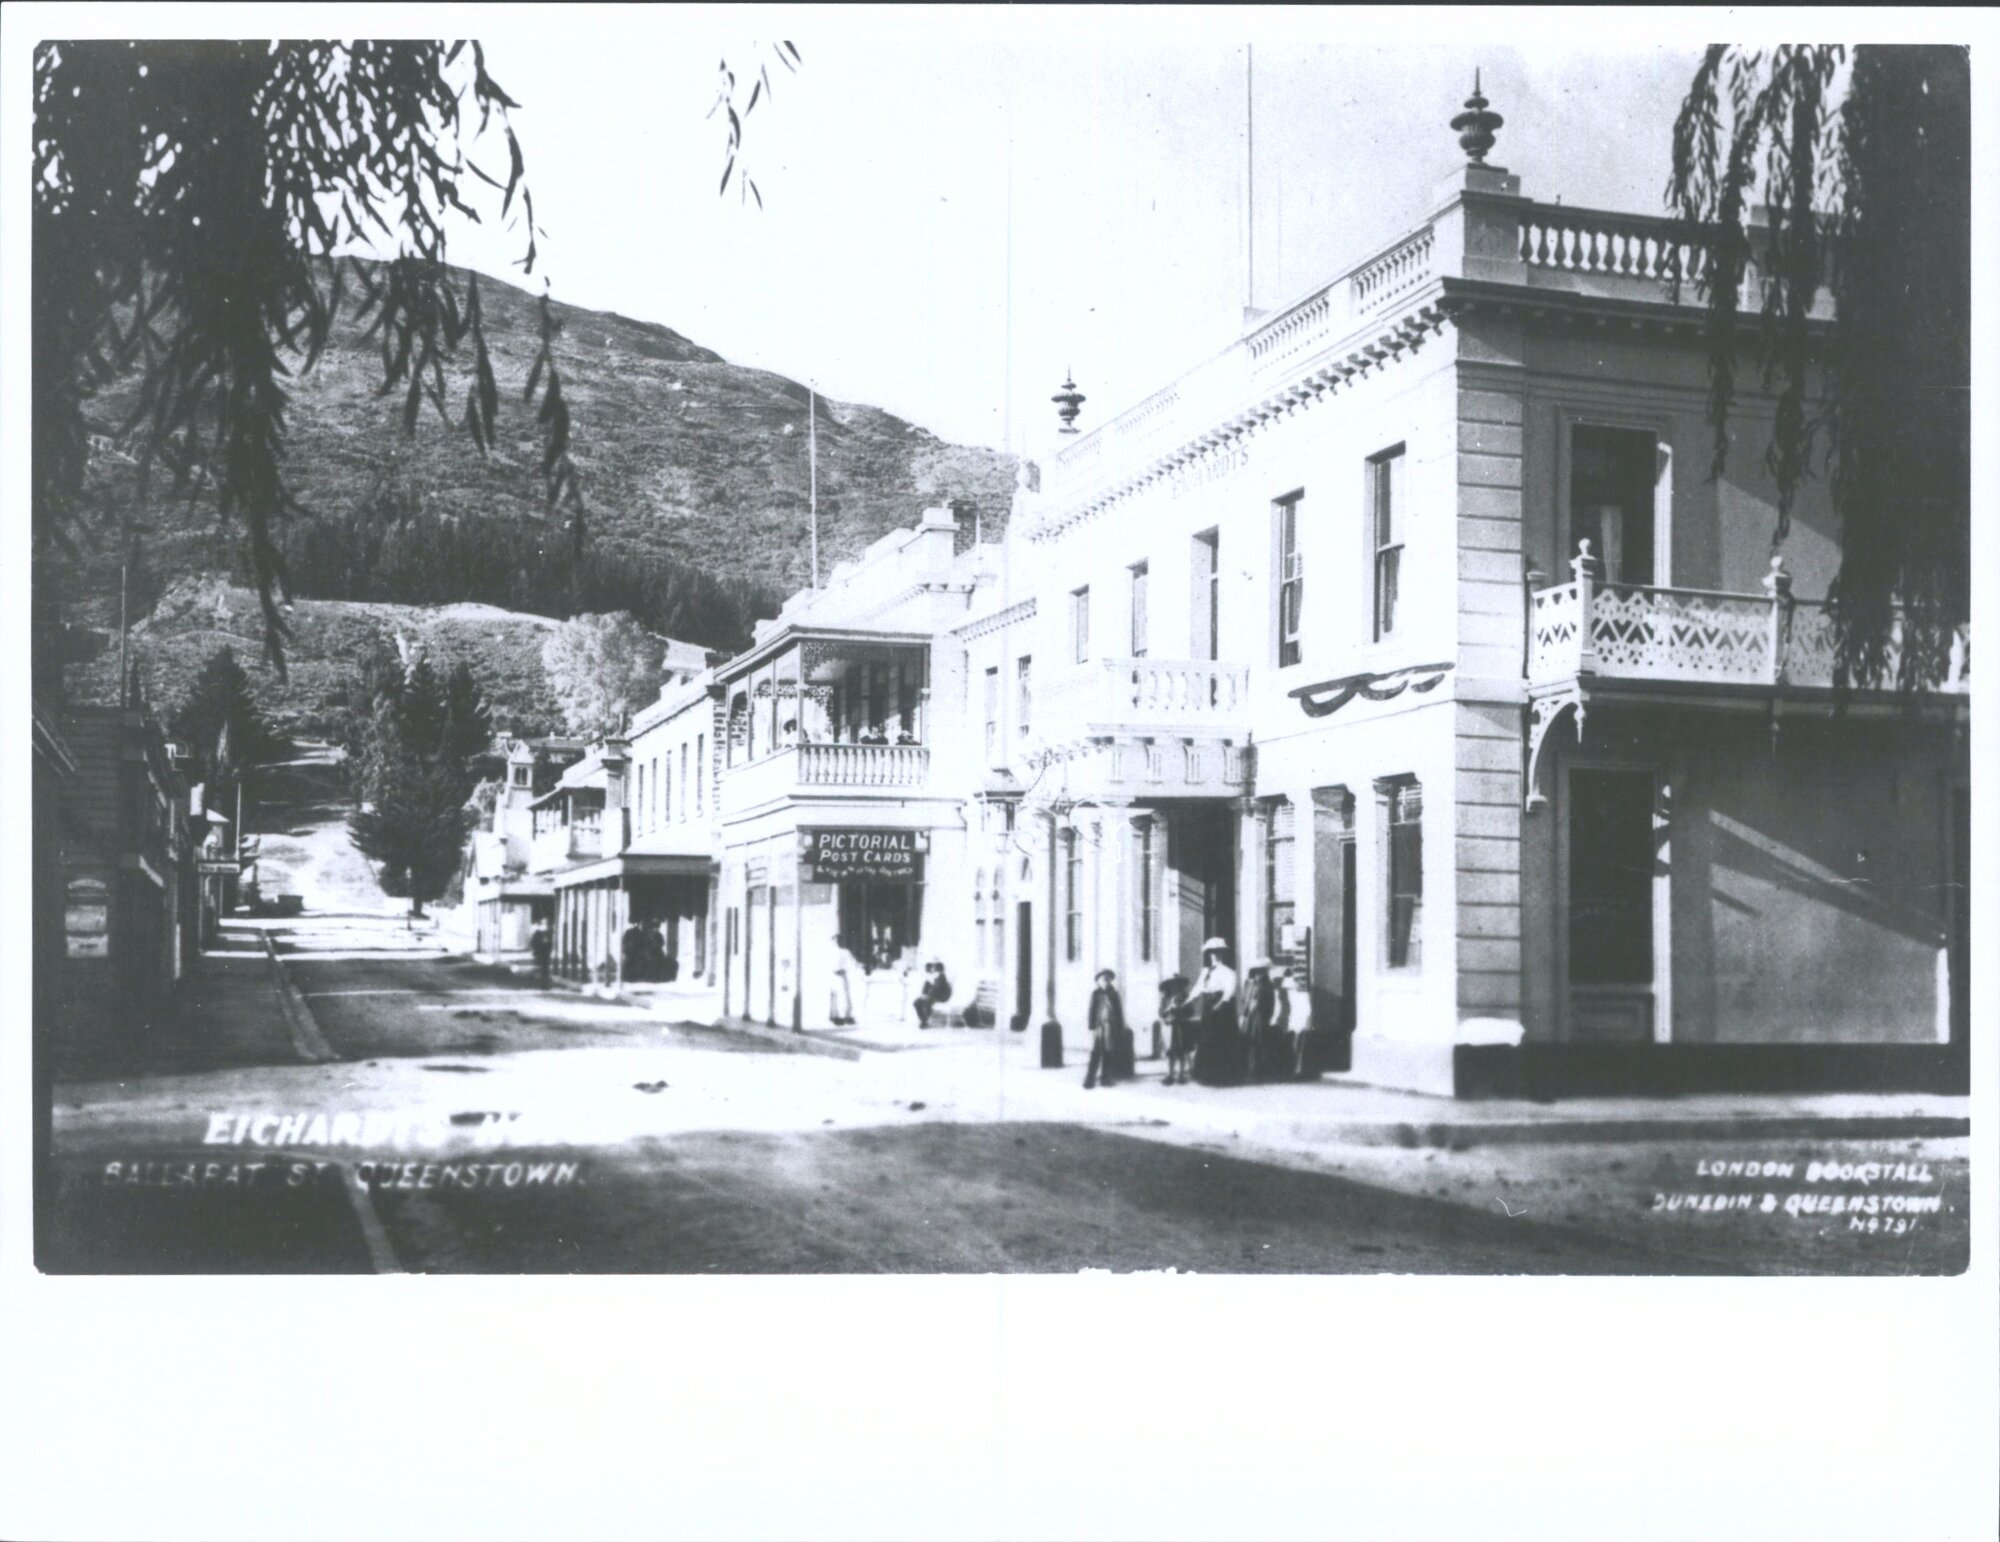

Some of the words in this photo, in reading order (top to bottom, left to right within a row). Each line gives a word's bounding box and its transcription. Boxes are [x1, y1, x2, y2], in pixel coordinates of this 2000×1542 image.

[818, 833, 911, 850] PICTORIAL
[818, 849, 858, 862] POST
[863, 850, 911, 863] CARDS
